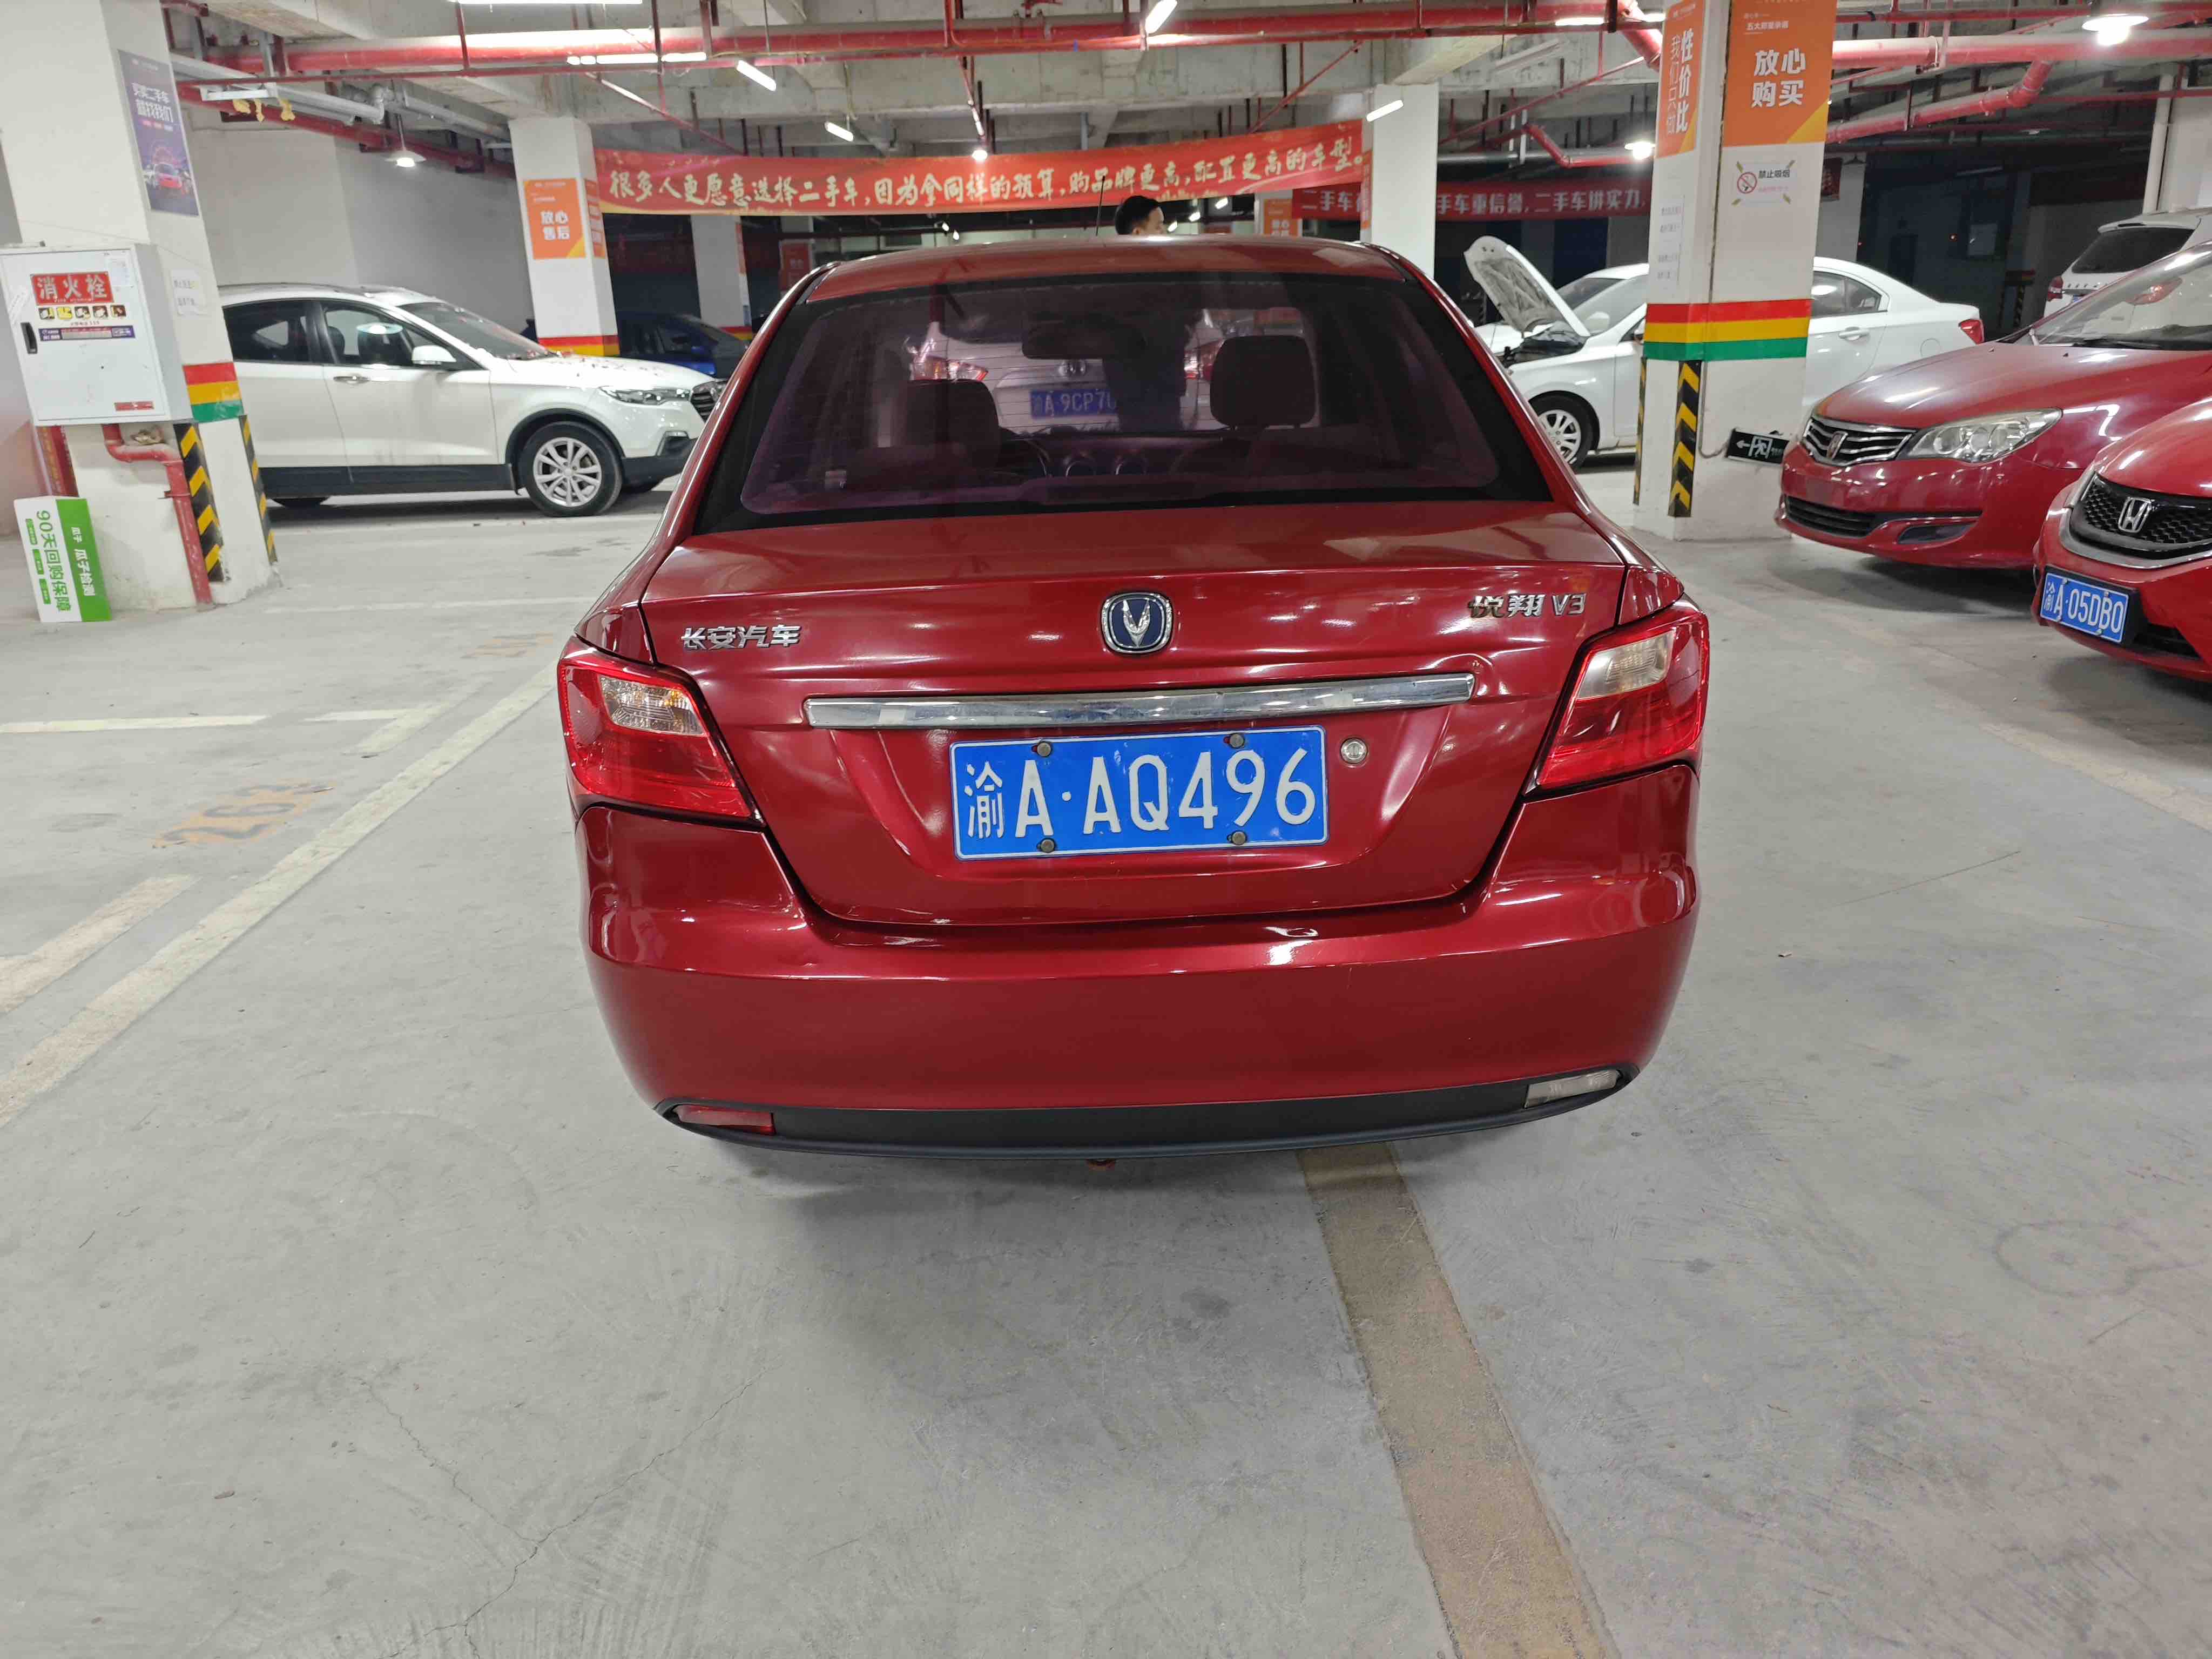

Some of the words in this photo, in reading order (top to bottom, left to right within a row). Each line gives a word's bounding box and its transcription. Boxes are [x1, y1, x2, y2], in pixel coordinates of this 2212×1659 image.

[1754, 48, 1806, 76] 放心
[1676, 28, 1694, 133] 性价比
[1751, 80, 1804, 108] 购买
[37, 274, 107, 300] 消火栓
[36, 510, 71, 611] 90天回购保障
[1468, 594, 1546, 618] 悦翔
[1552, 592, 1587, 616] V3
[680, 624, 801, 650] 长安汽车
[964, 747, 1316, 839] 渝A·AQ496
